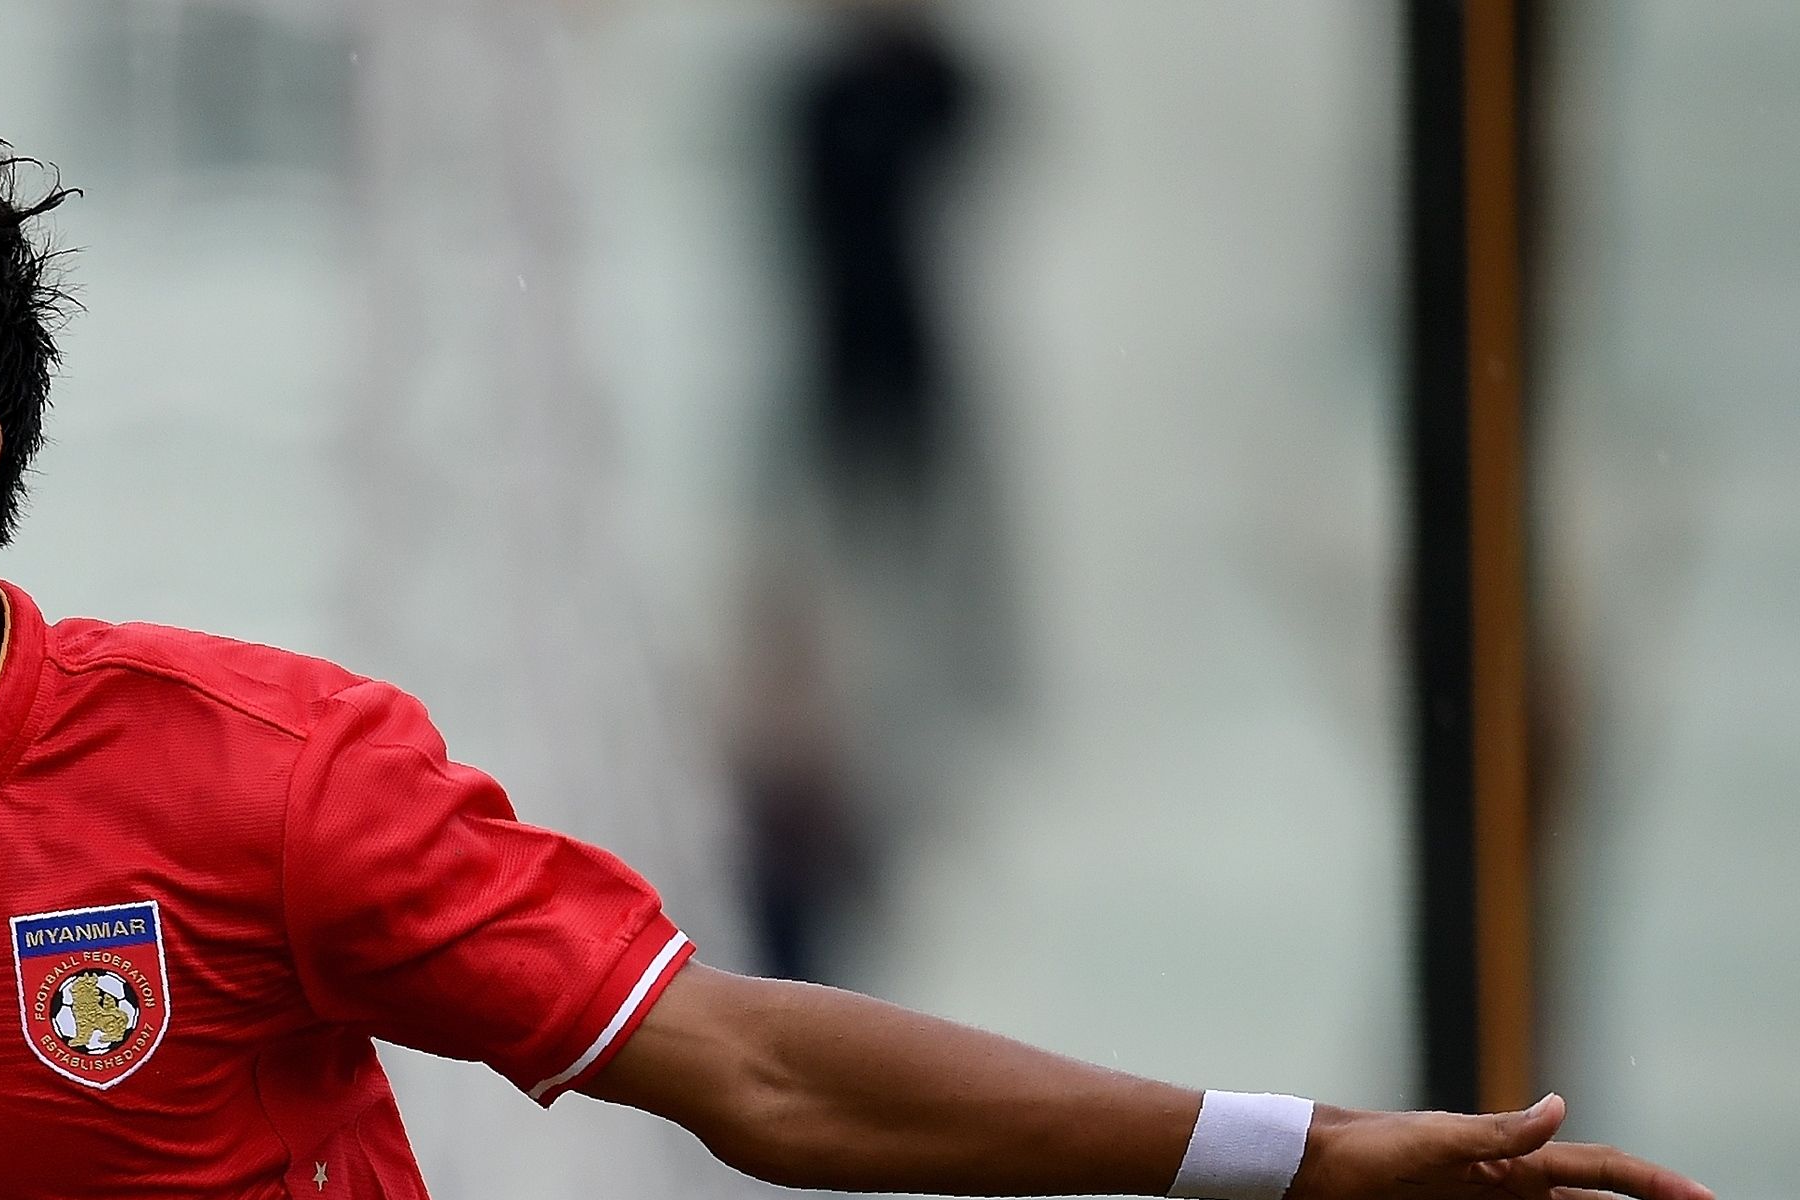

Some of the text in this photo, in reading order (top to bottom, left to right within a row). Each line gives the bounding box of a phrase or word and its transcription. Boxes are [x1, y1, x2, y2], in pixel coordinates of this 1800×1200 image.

[25, 918, 146, 948] MYANMAR
[35, 951, 156, 1021] FOOTBALL FEDERATION
[41, 1034, 134, 1071] ESTABLISHED
